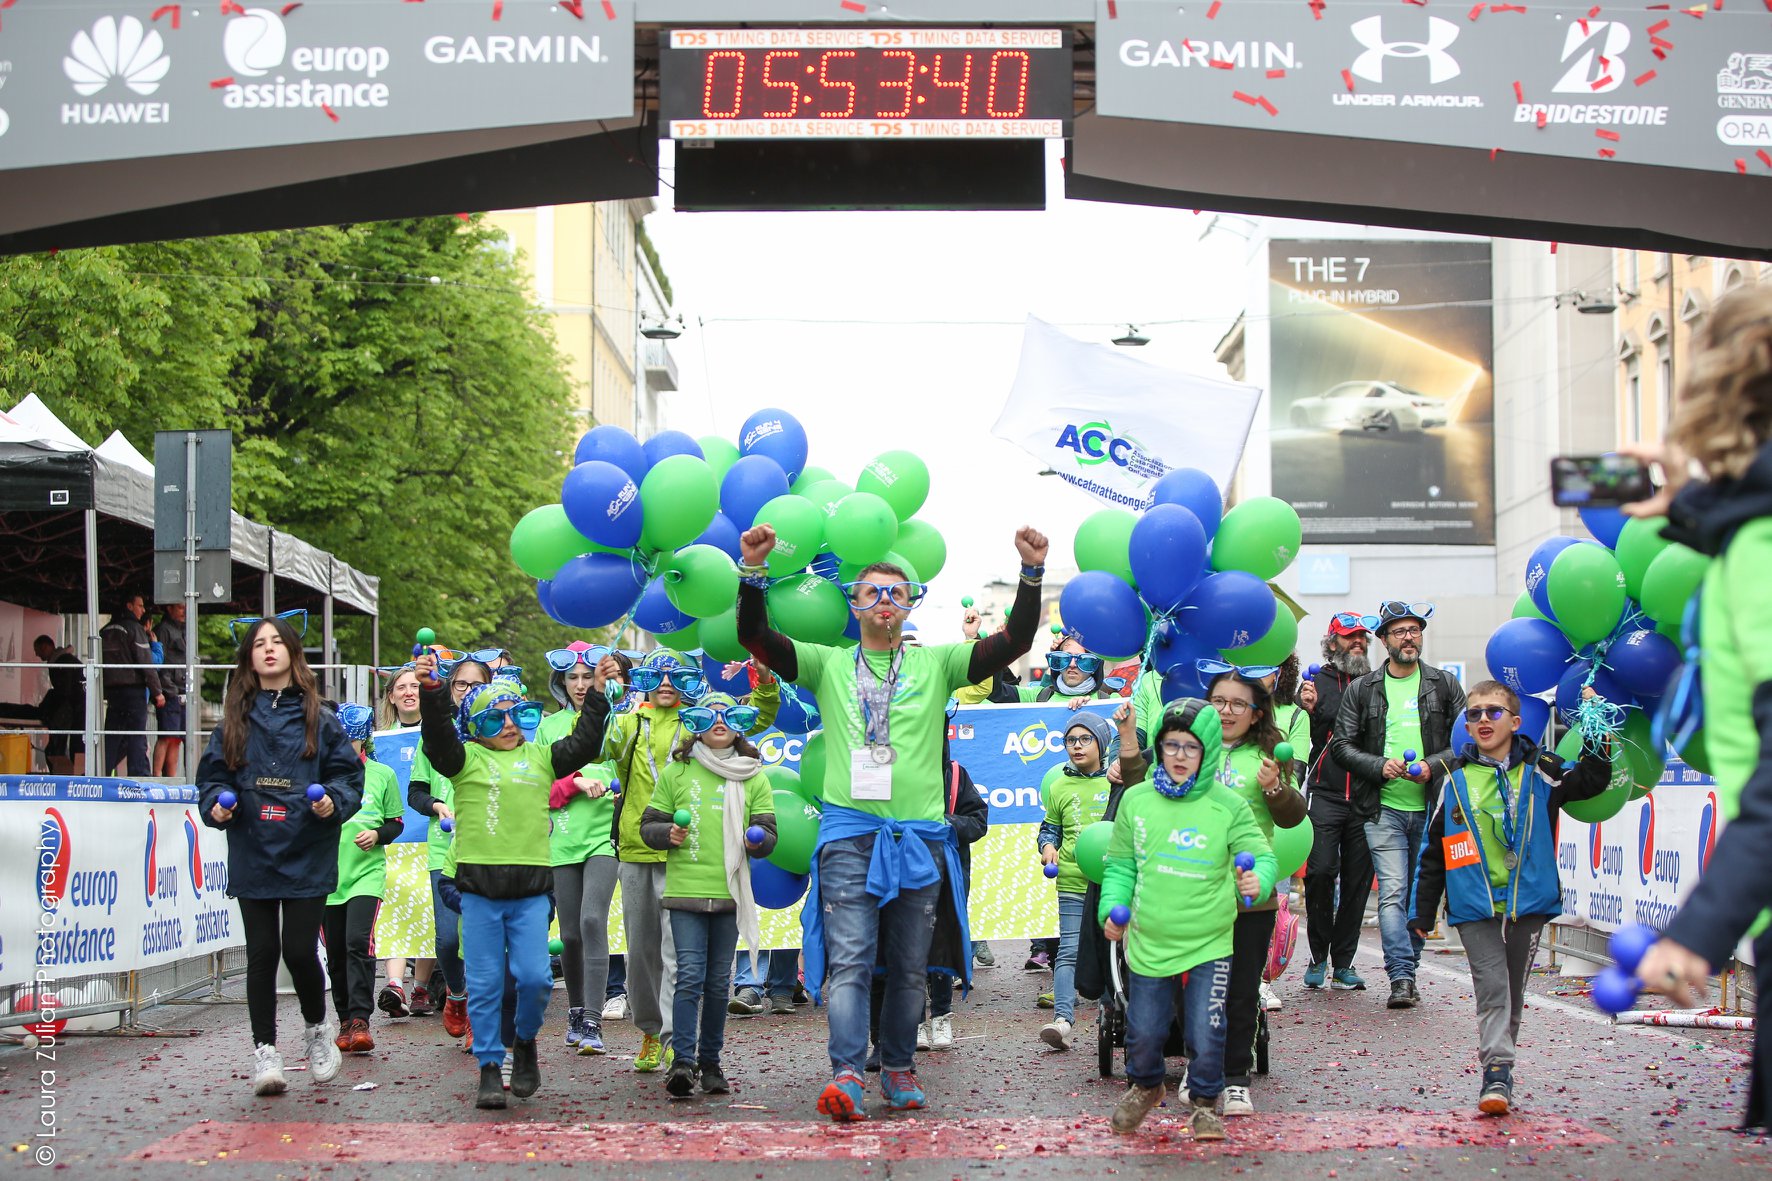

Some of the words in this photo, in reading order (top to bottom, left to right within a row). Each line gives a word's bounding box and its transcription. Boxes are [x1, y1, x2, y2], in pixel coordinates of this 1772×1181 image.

[424, 35, 602, 64] GARMIN
[675, 32, 708, 45] TDS
[715, 32, 765, 45] TIMING
[771, 32, 801, 45] DATA
[807, 32, 864, 45] SERVICE
[870, 32, 902, 45] TDS
[910, 32, 960, 45] TIMING
[966, 32, 997, 45] DATA
[1002, 32, 1060, 45] SERVICE
[1118, 39, 1296, 69] GARMIN
[291, 45, 389, 77] europ
[223, 77, 389, 109] assistance
[702, 50, 1030, 119] 05:53:40
[61, 103, 170, 124] HUAWEI
[1332, 93, 1396, 107] UNDER
[1400, 94, 1480, 108] ARMOUR
[1513, 103, 1669, 125] BRIDGESTONE
[675, 123, 708, 136] TDS
[715, 123, 765, 136] TIMING
[771, 123, 801, 136] DATA
[807, 123, 864, 136] SERVICE
[870, 123, 902, 136] TDS
[910, 123, 960, 136] TIMING
[966, 123, 997, 136] DATA
[1002, 123, 1060, 136] SERVICE
[1723, 121, 1771, 139] ORA
[1287, 256, 1348, 283] THE
[1353, 257, 1371, 283] 7
[1288, 289, 1346, 304] PLUG-IN
[1347, 289, 1400, 305] HYBRID
[1055, 424, 1133, 468] ACC
[1003, 730, 1065, 755] ACC
[18, 779, 57, 797] #corricon
[67, 781, 103, 798] #corricon
[1167, 828, 1208, 849] ACC
[1450, 840, 1474, 861] JBL
[1559, 842, 1577, 879] europ
[1603, 845, 1623, 886] europ
[1654, 849, 1680, 894] europ
[71, 870, 118, 915] europ
[158, 865, 178, 907] europ
[204, 861, 227, 899] europ
[1589, 883, 1623, 925] assistance
[143, 909, 182, 956] assistance
[195, 901, 230, 944] assistance
[1208, 960, 1230, 1012] ROCK
